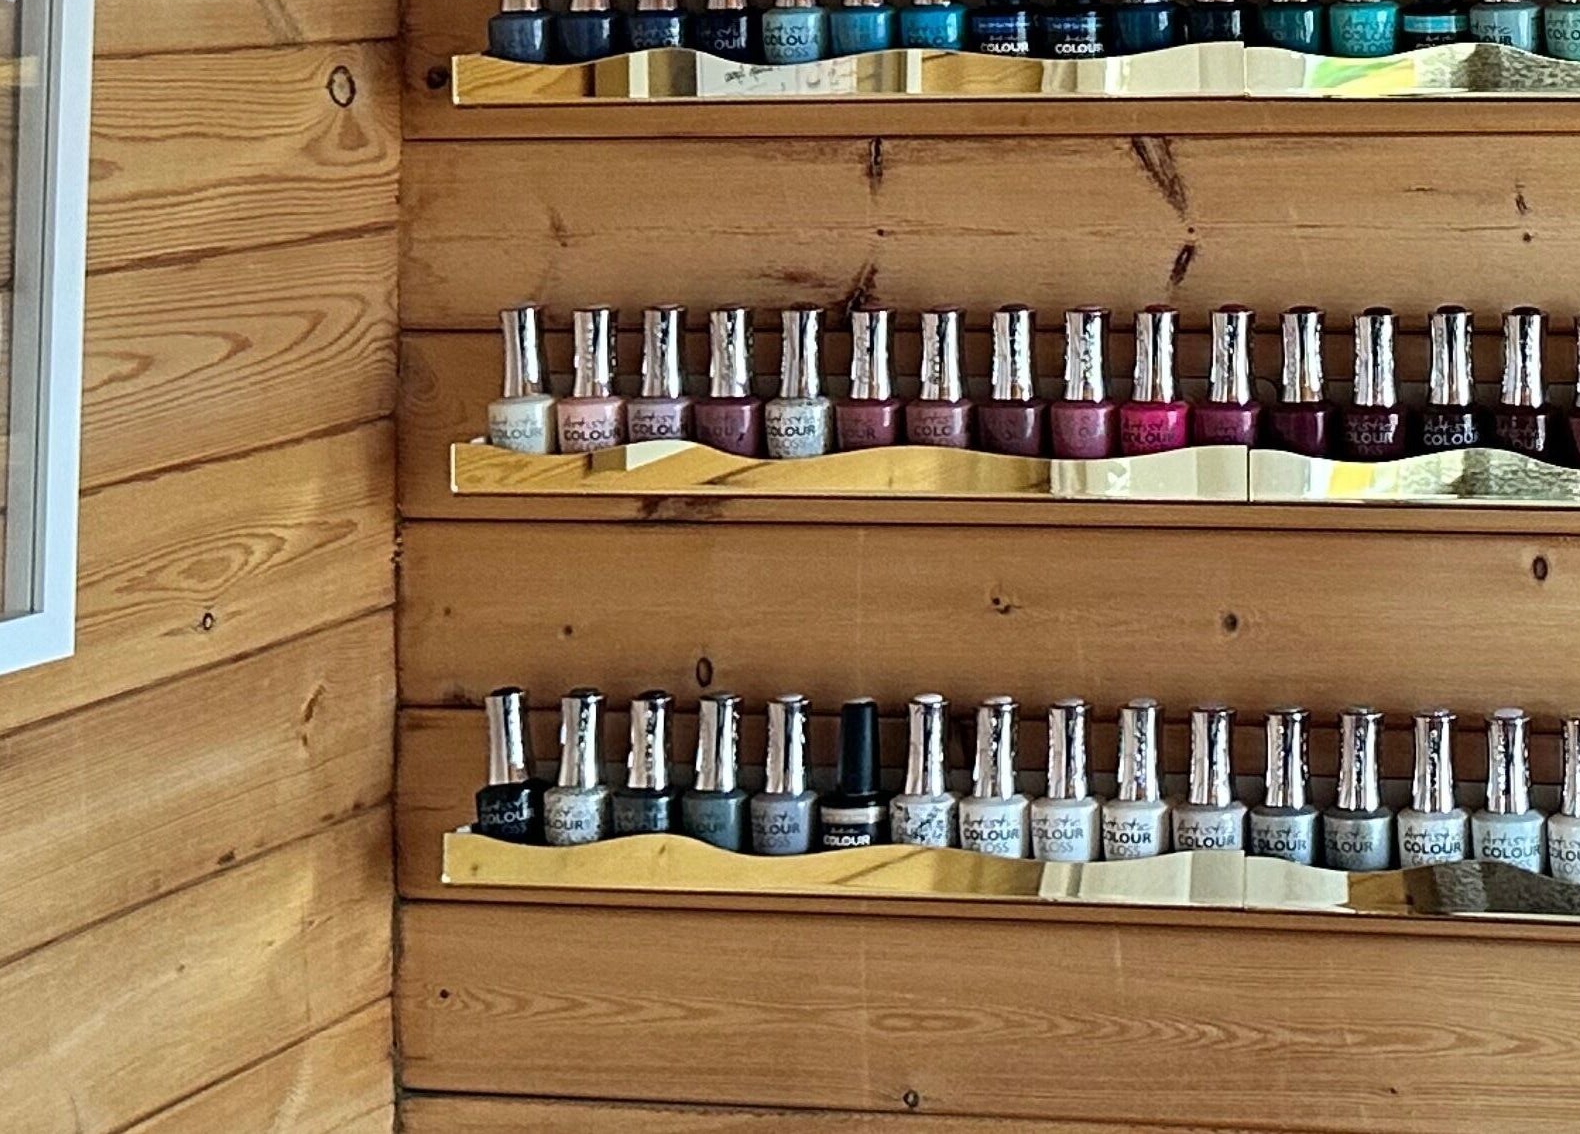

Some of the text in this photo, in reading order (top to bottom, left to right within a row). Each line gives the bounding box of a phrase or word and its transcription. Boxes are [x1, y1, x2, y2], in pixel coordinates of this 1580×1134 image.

[981, 41, 1029, 53] COLOUR
[1055, 43, 1104, 54] COLOUR
[964, 829, 1019, 840] COLOUR
[1179, 836, 1234, 847] COLOUR
[1405, 841, 1462, 853] COLOUR
